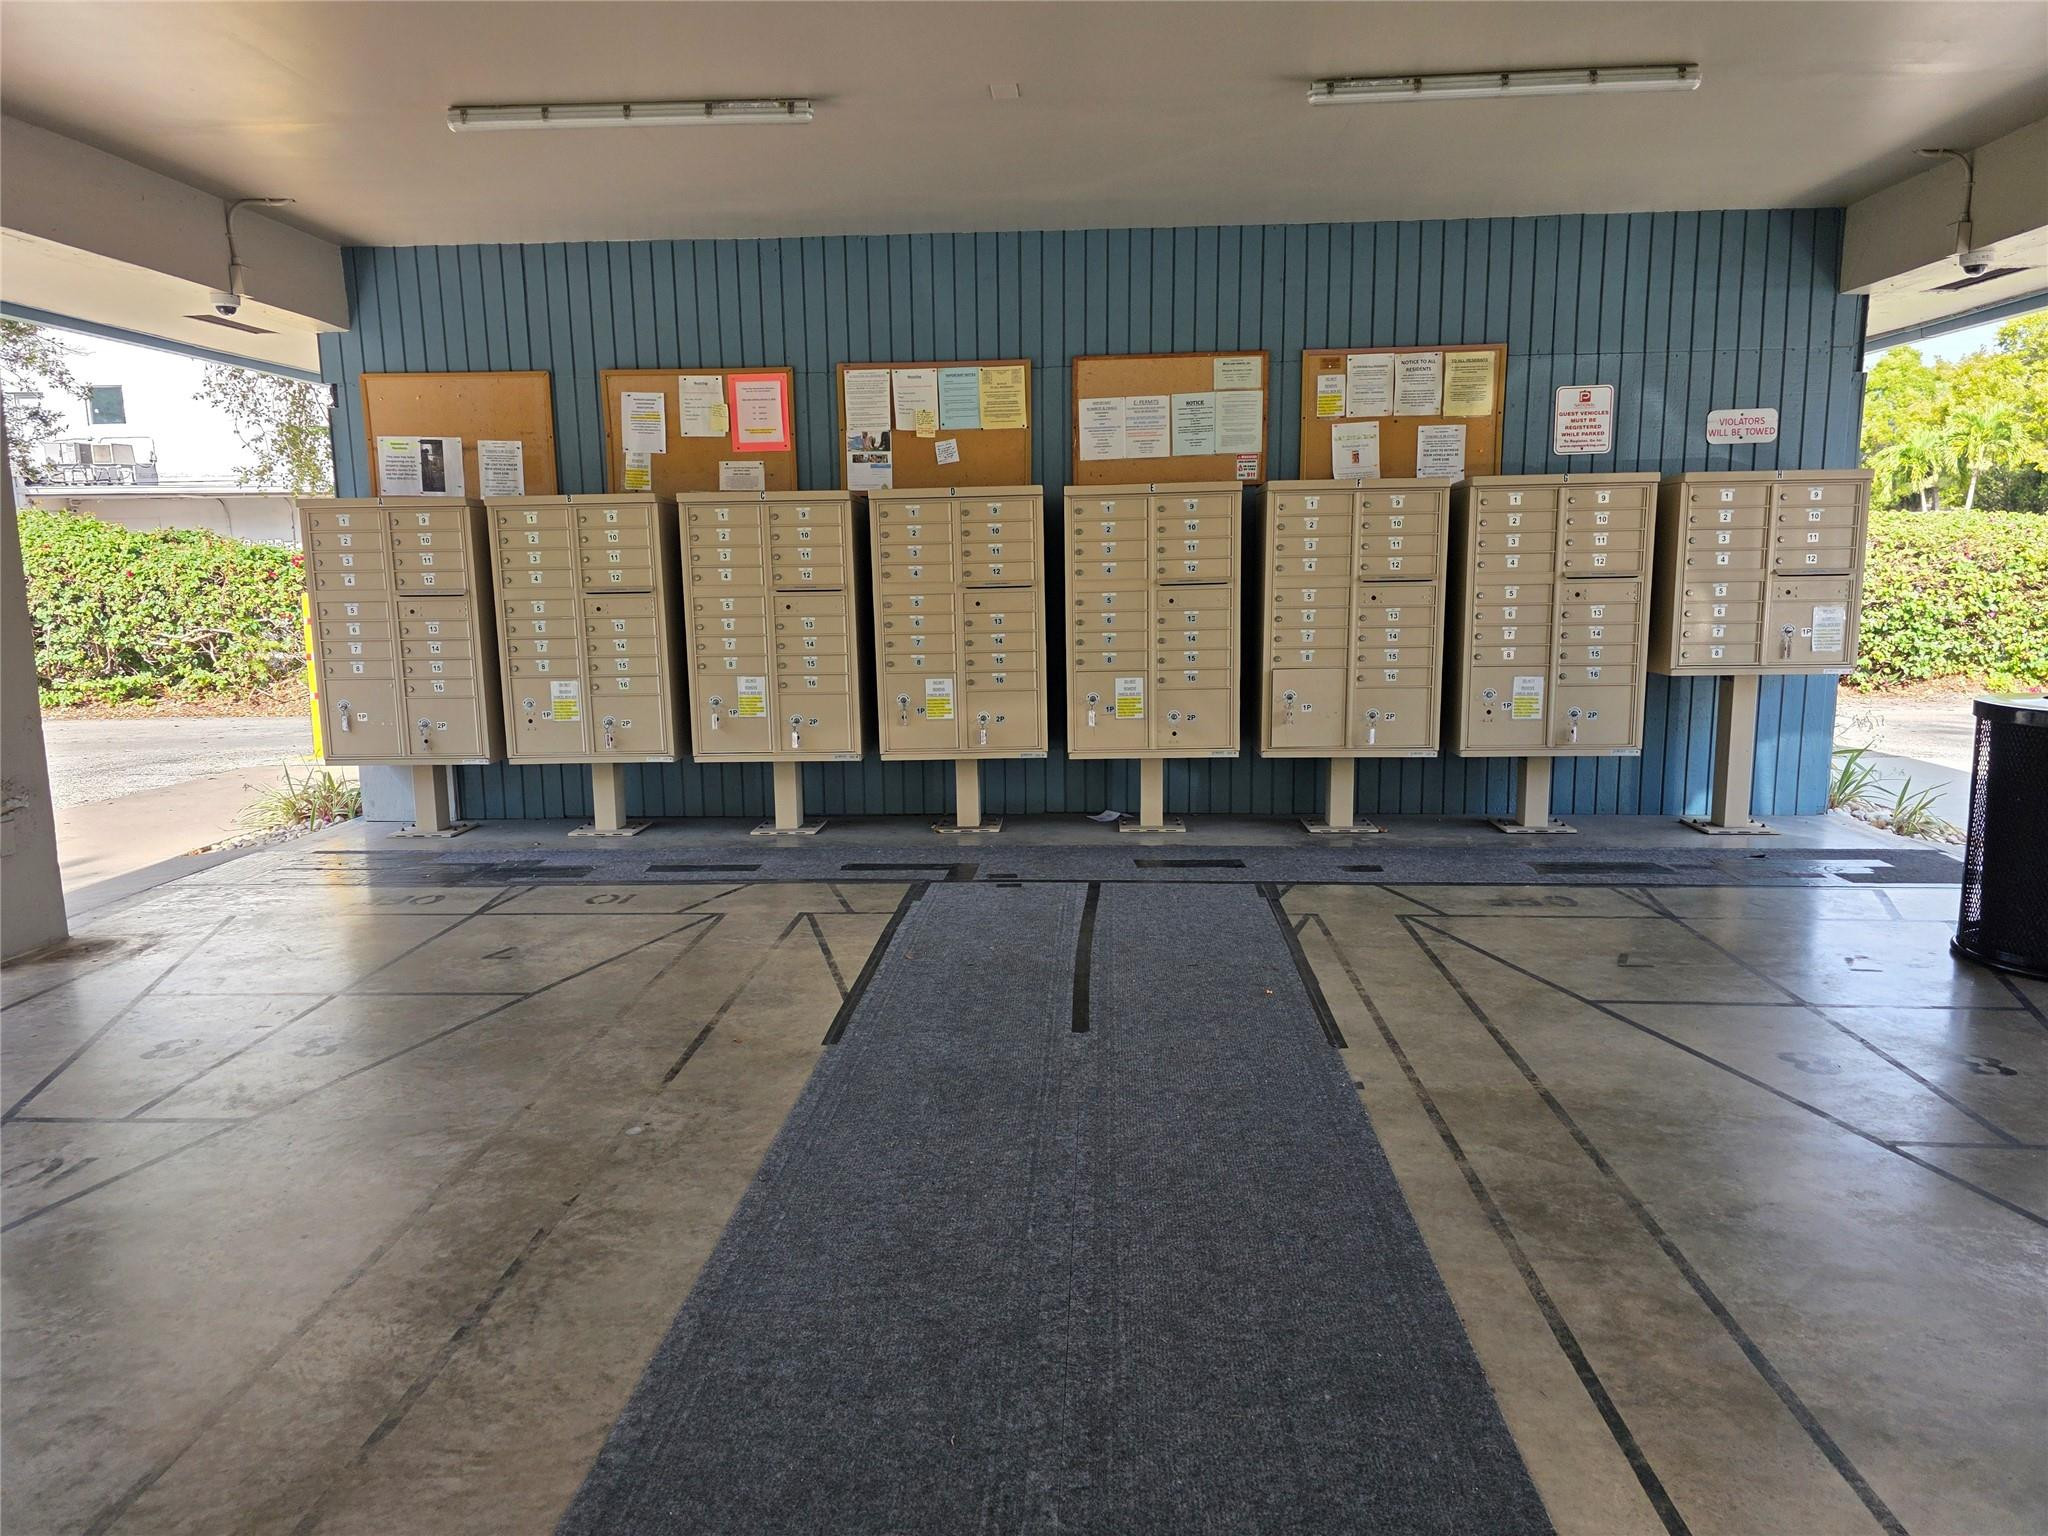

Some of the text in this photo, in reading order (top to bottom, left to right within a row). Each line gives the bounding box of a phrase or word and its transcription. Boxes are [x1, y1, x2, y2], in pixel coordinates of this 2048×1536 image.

[1719, 417, 1766, 426] VIOLATORS
[1708, 426, 1776, 437] WILL BE TOWED
